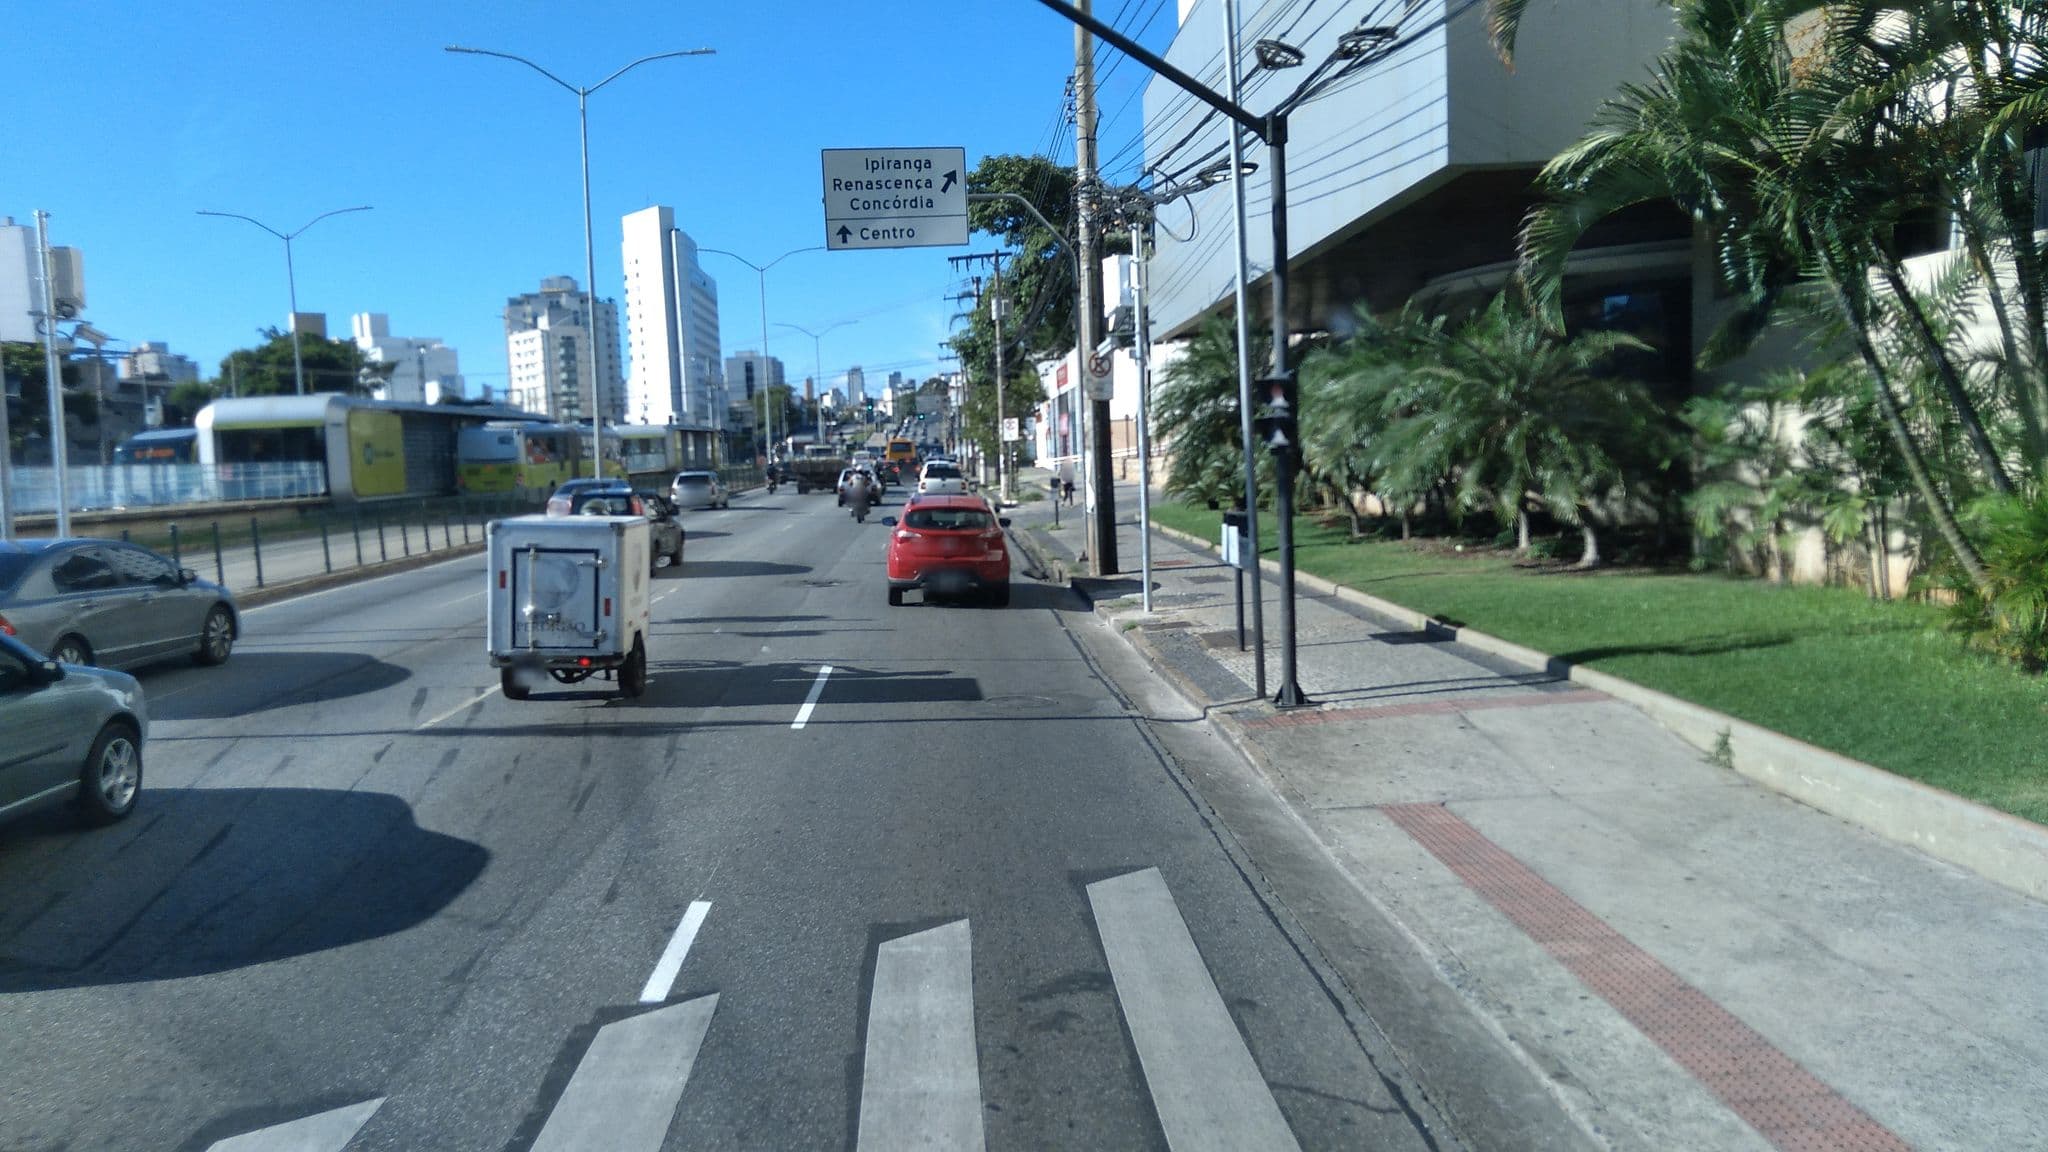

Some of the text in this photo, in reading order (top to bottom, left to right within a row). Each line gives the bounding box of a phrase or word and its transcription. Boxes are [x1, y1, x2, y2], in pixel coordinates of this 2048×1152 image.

[865, 157, 932, 173] Ipiranga
[833, 178, 933, 192] Renascença
[850, 195, 934, 211] Concórdia
[860, 226, 915, 240] Centro
